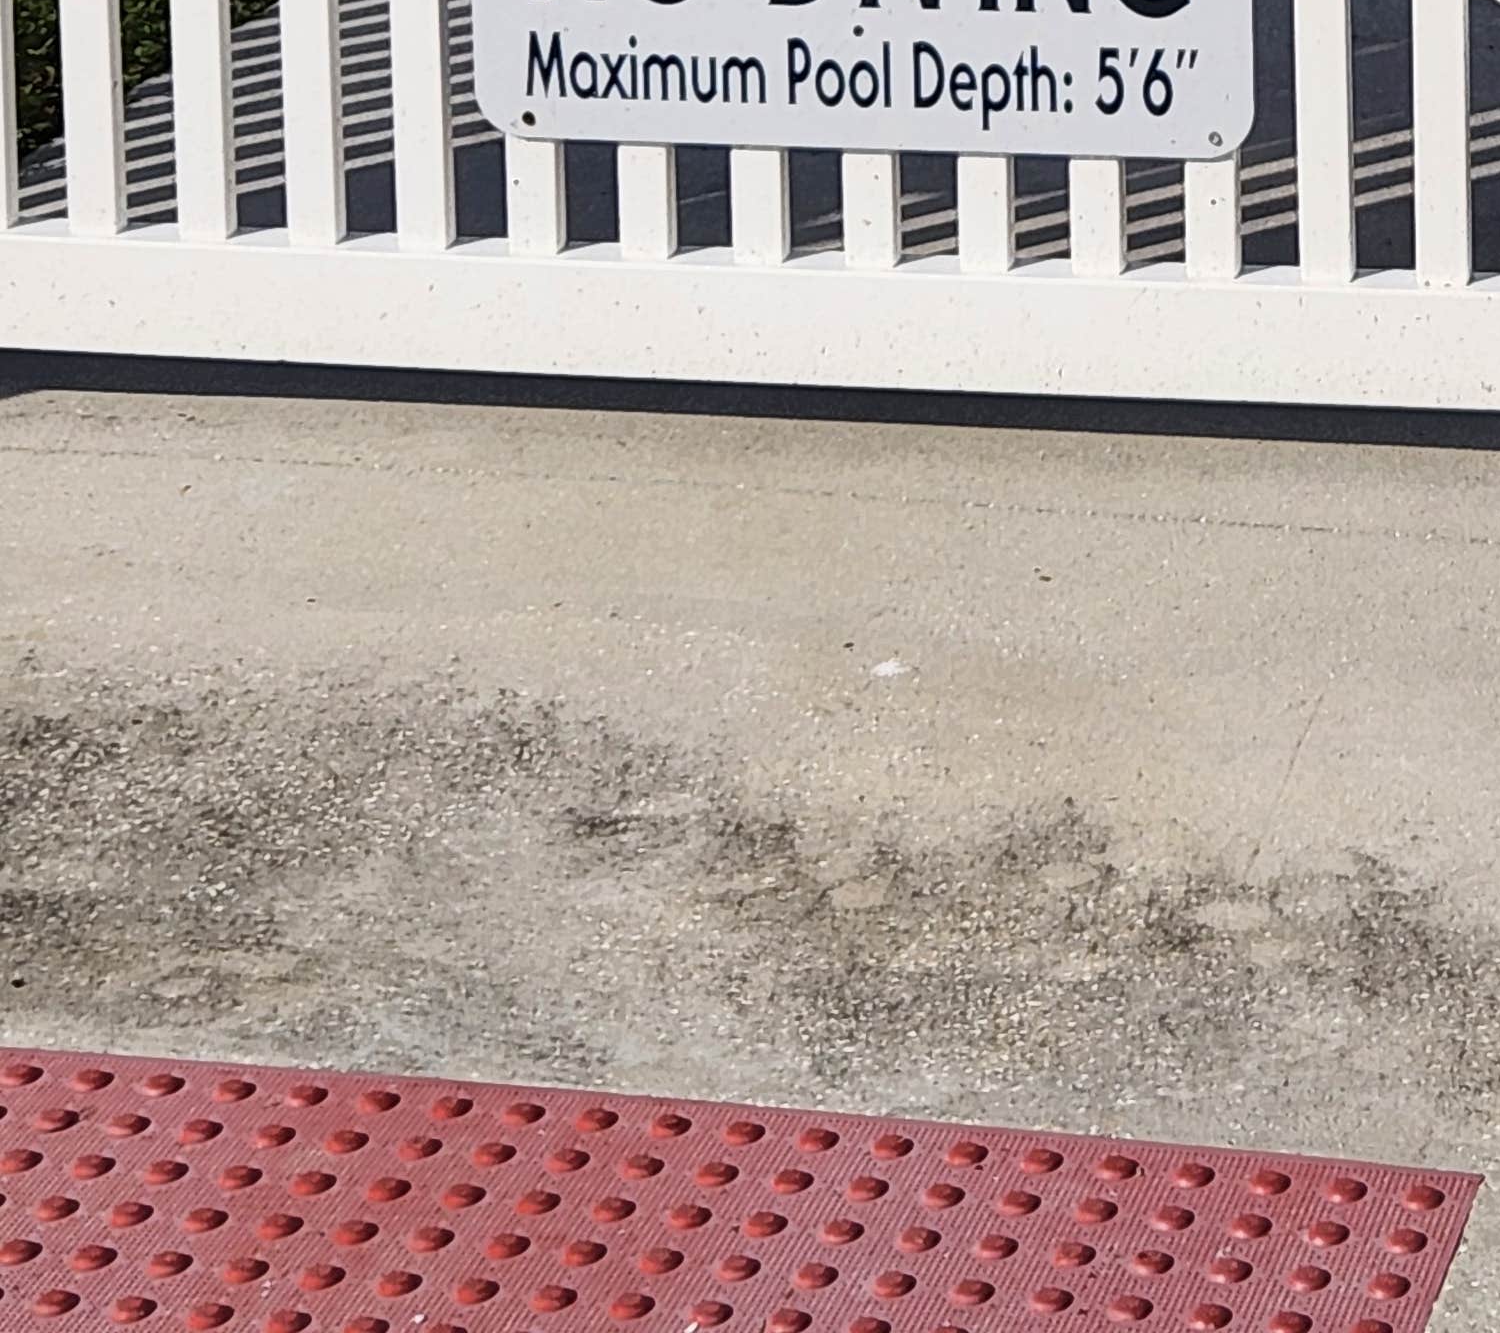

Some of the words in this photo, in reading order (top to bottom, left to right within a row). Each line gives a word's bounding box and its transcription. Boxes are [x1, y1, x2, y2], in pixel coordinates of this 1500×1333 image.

[525, 29, 768, 105] Maximum
[786, 36, 893, 110] Pool
[911, 39, 1074, 131] Depth:
[1094, 46, 1199, 118] 5'6"
